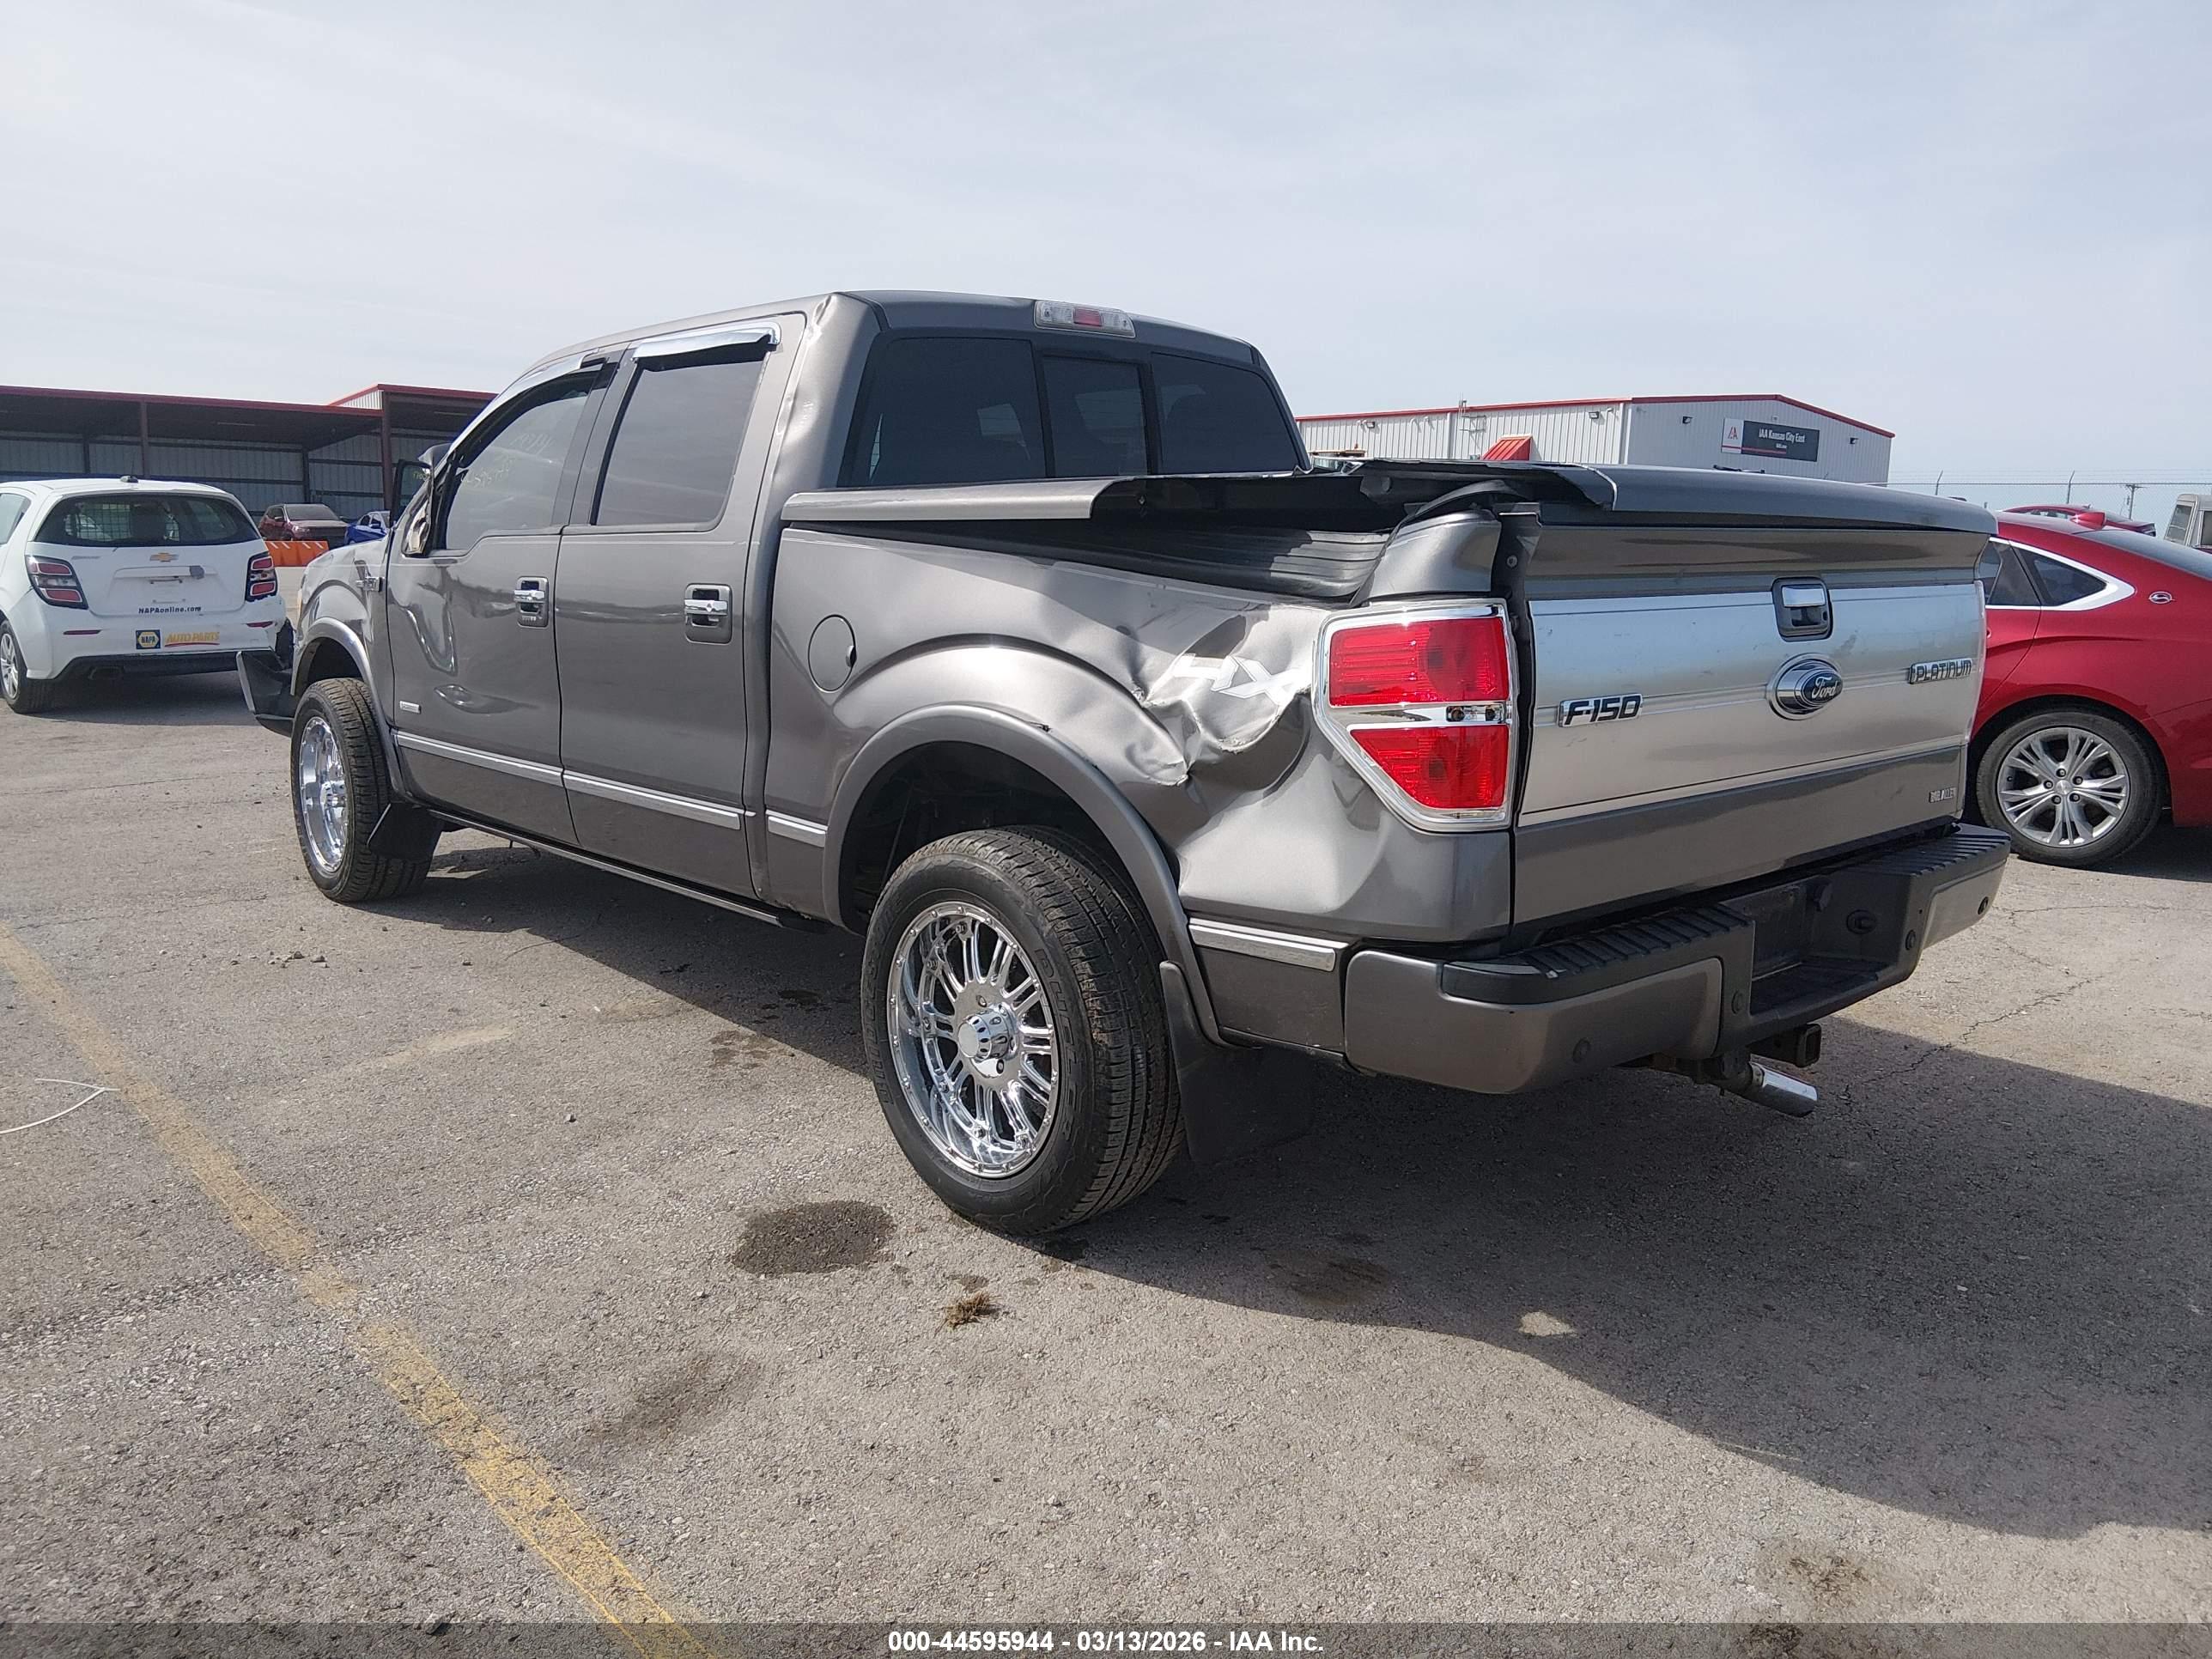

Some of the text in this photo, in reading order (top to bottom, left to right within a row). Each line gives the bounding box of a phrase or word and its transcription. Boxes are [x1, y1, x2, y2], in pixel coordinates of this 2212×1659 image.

[1759, 428, 1805, 443] IAA Kansas City East
[138, 605, 202, 615] NAPAonline.com
[141, 630, 220, 644] NAPA AUTO PARTS
[1916, 659, 1972, 684] PLATINUM
[1811, 676, 1838, 699] Ford
[1564, 695, 1642, 726] F-150
